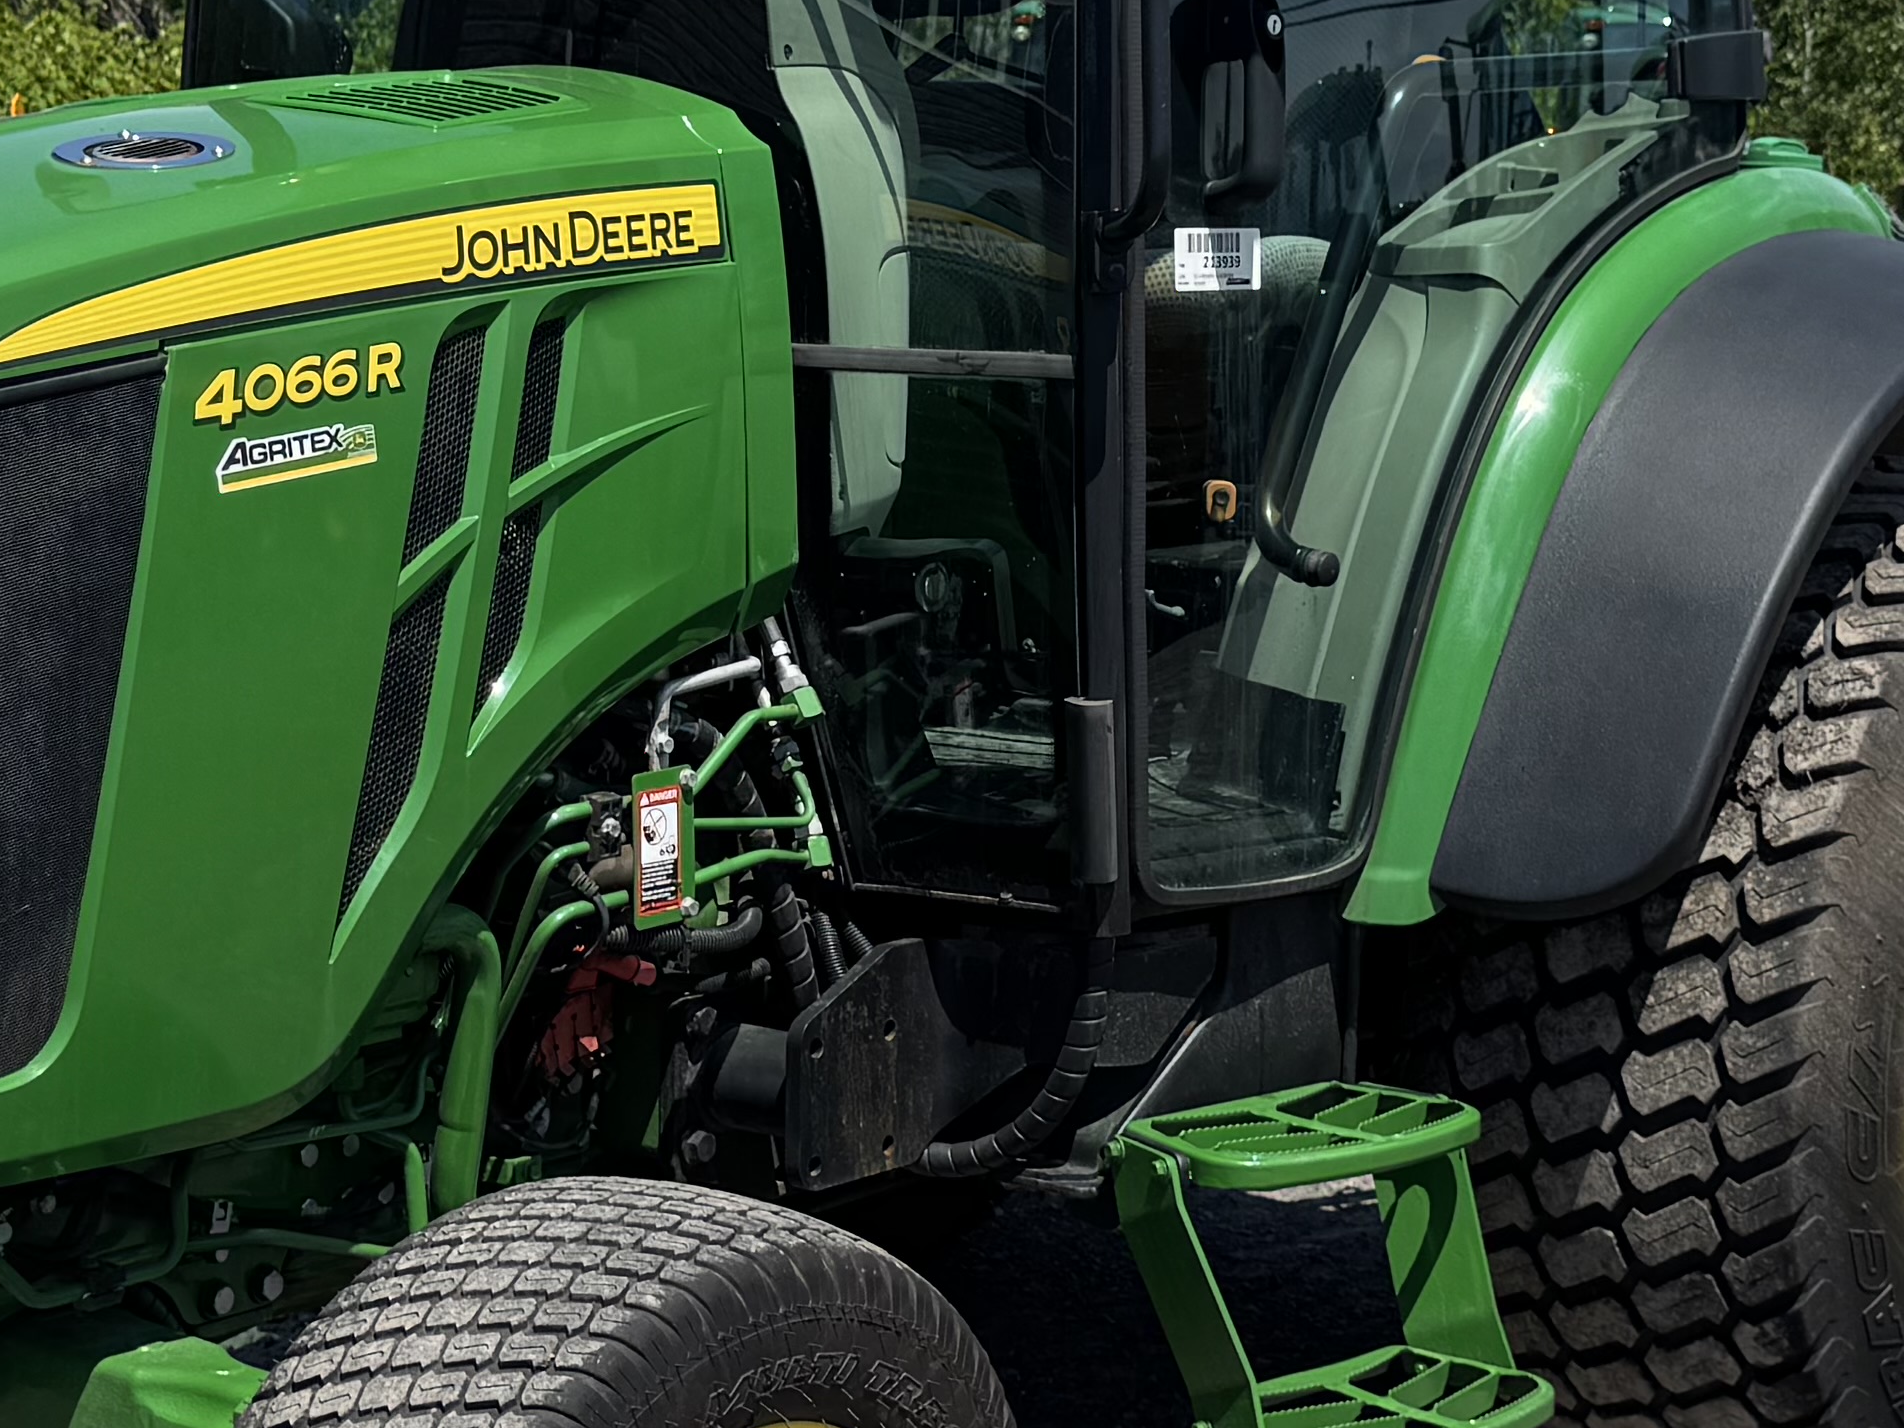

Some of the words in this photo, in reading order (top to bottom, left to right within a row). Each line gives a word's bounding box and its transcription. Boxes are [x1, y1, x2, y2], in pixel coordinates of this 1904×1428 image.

[441, 222, 562, 277] JOHN
[568, 210, 695, 259] DEERE
[221, 428, 344, 471] AGRITEX
